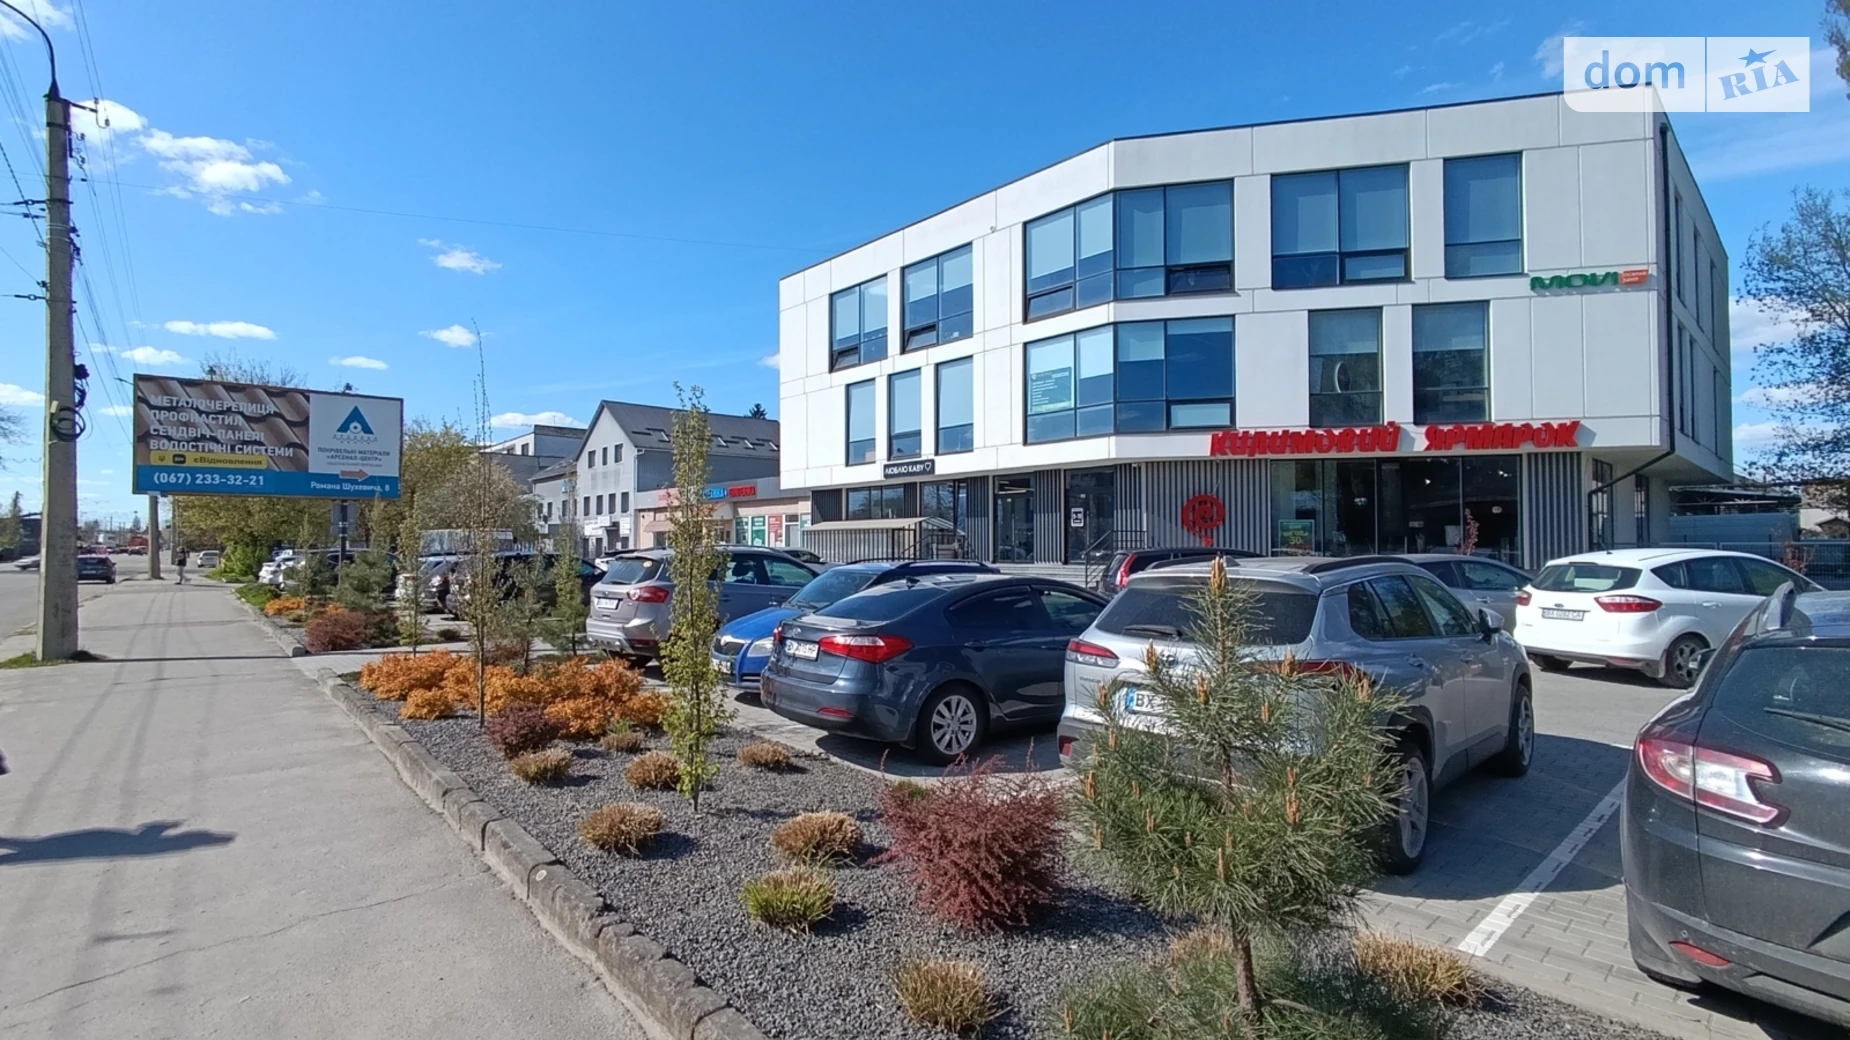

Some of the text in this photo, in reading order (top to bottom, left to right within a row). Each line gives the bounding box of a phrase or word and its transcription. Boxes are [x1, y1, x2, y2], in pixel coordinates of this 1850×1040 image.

[149, 396, 275, 415] МЕТАЛОЧЕРЕПИЦЯ
[150, 409, 243, 426] ПРОФНАСТИЛ
[149, 425, 265, 441] СЕНДВІЧ-ПАНЕЛІ
[1210, 420, 1581, 457] КИЛИМОВИЙ ЯРМАРОК
[150, 439, 294, 457] ВОДОСТІЧНІ СИСТЕМИ
[193, 455, 263, 466] єВідновлення
[885, 463, 925, 474] ЛЮБЛЮ КАВУ
[153, 472, 264, 486] (067) 233-32-21
[310, 481, 341, 490] Романа
